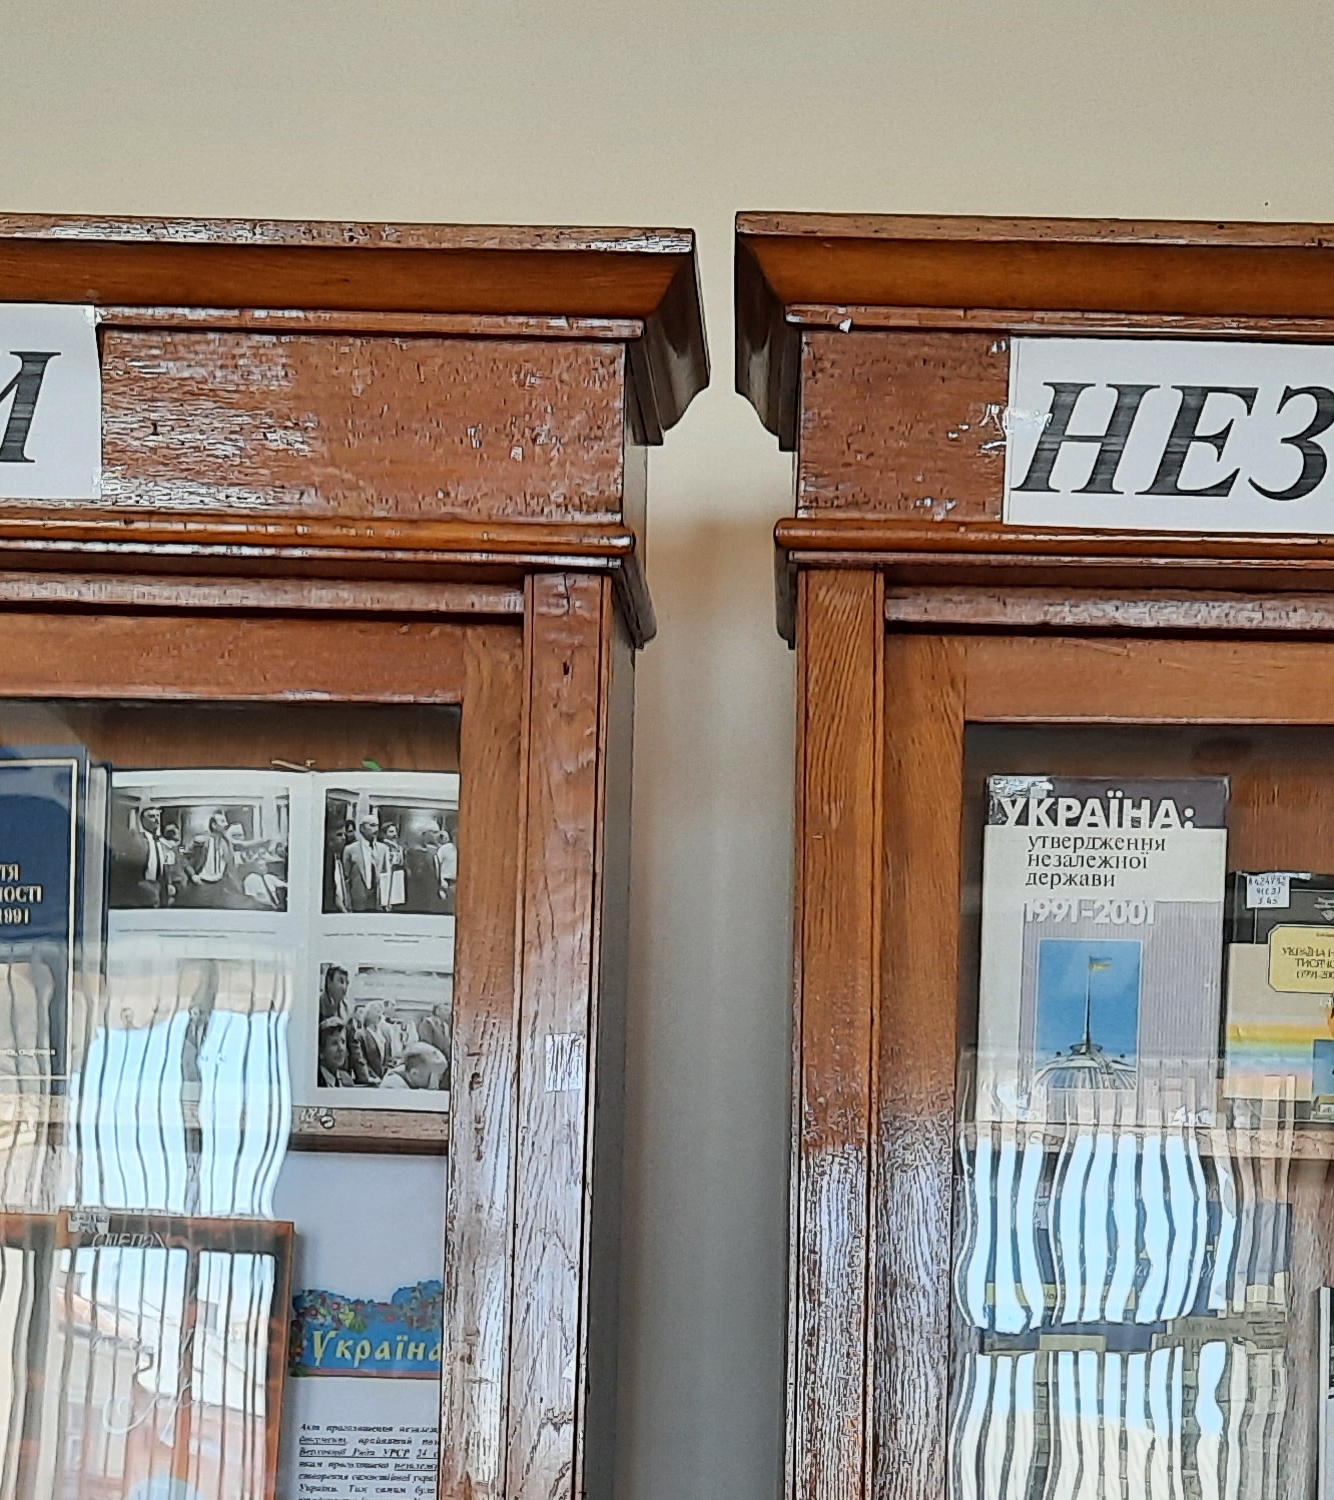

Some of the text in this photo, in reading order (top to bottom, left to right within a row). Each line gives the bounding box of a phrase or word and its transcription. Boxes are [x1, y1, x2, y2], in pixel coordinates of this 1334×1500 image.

[1000, 789, 1195, 829] УКРАЇНА:
[1027, 835, 1166, 853] утвердження
[1027, 851, 1148, 870] незалежної
[1025, 871, 1116, 889] держави
[1025, 898, 1155, 925] 1991-2001
